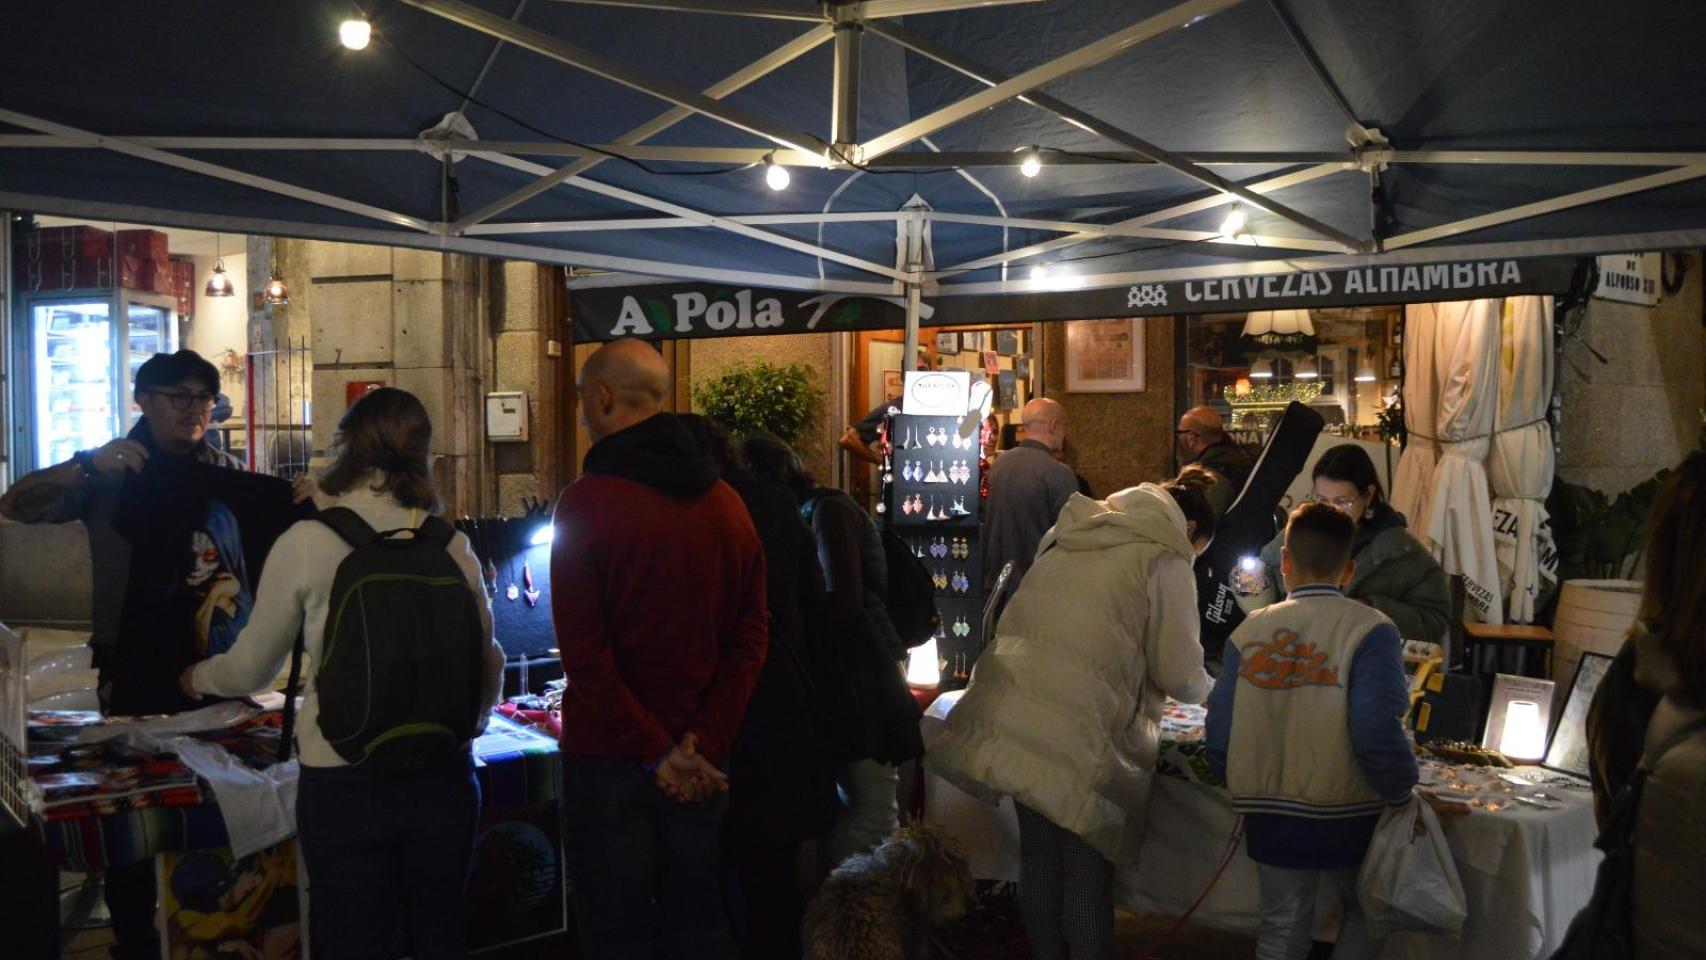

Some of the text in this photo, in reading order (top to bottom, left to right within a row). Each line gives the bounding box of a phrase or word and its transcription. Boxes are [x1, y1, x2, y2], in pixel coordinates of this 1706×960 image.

[1606, 271, 1640, 291] ALFONSO
[609, 295, 655, 336] A
[1205, 581, 1233, 624] Gibson
